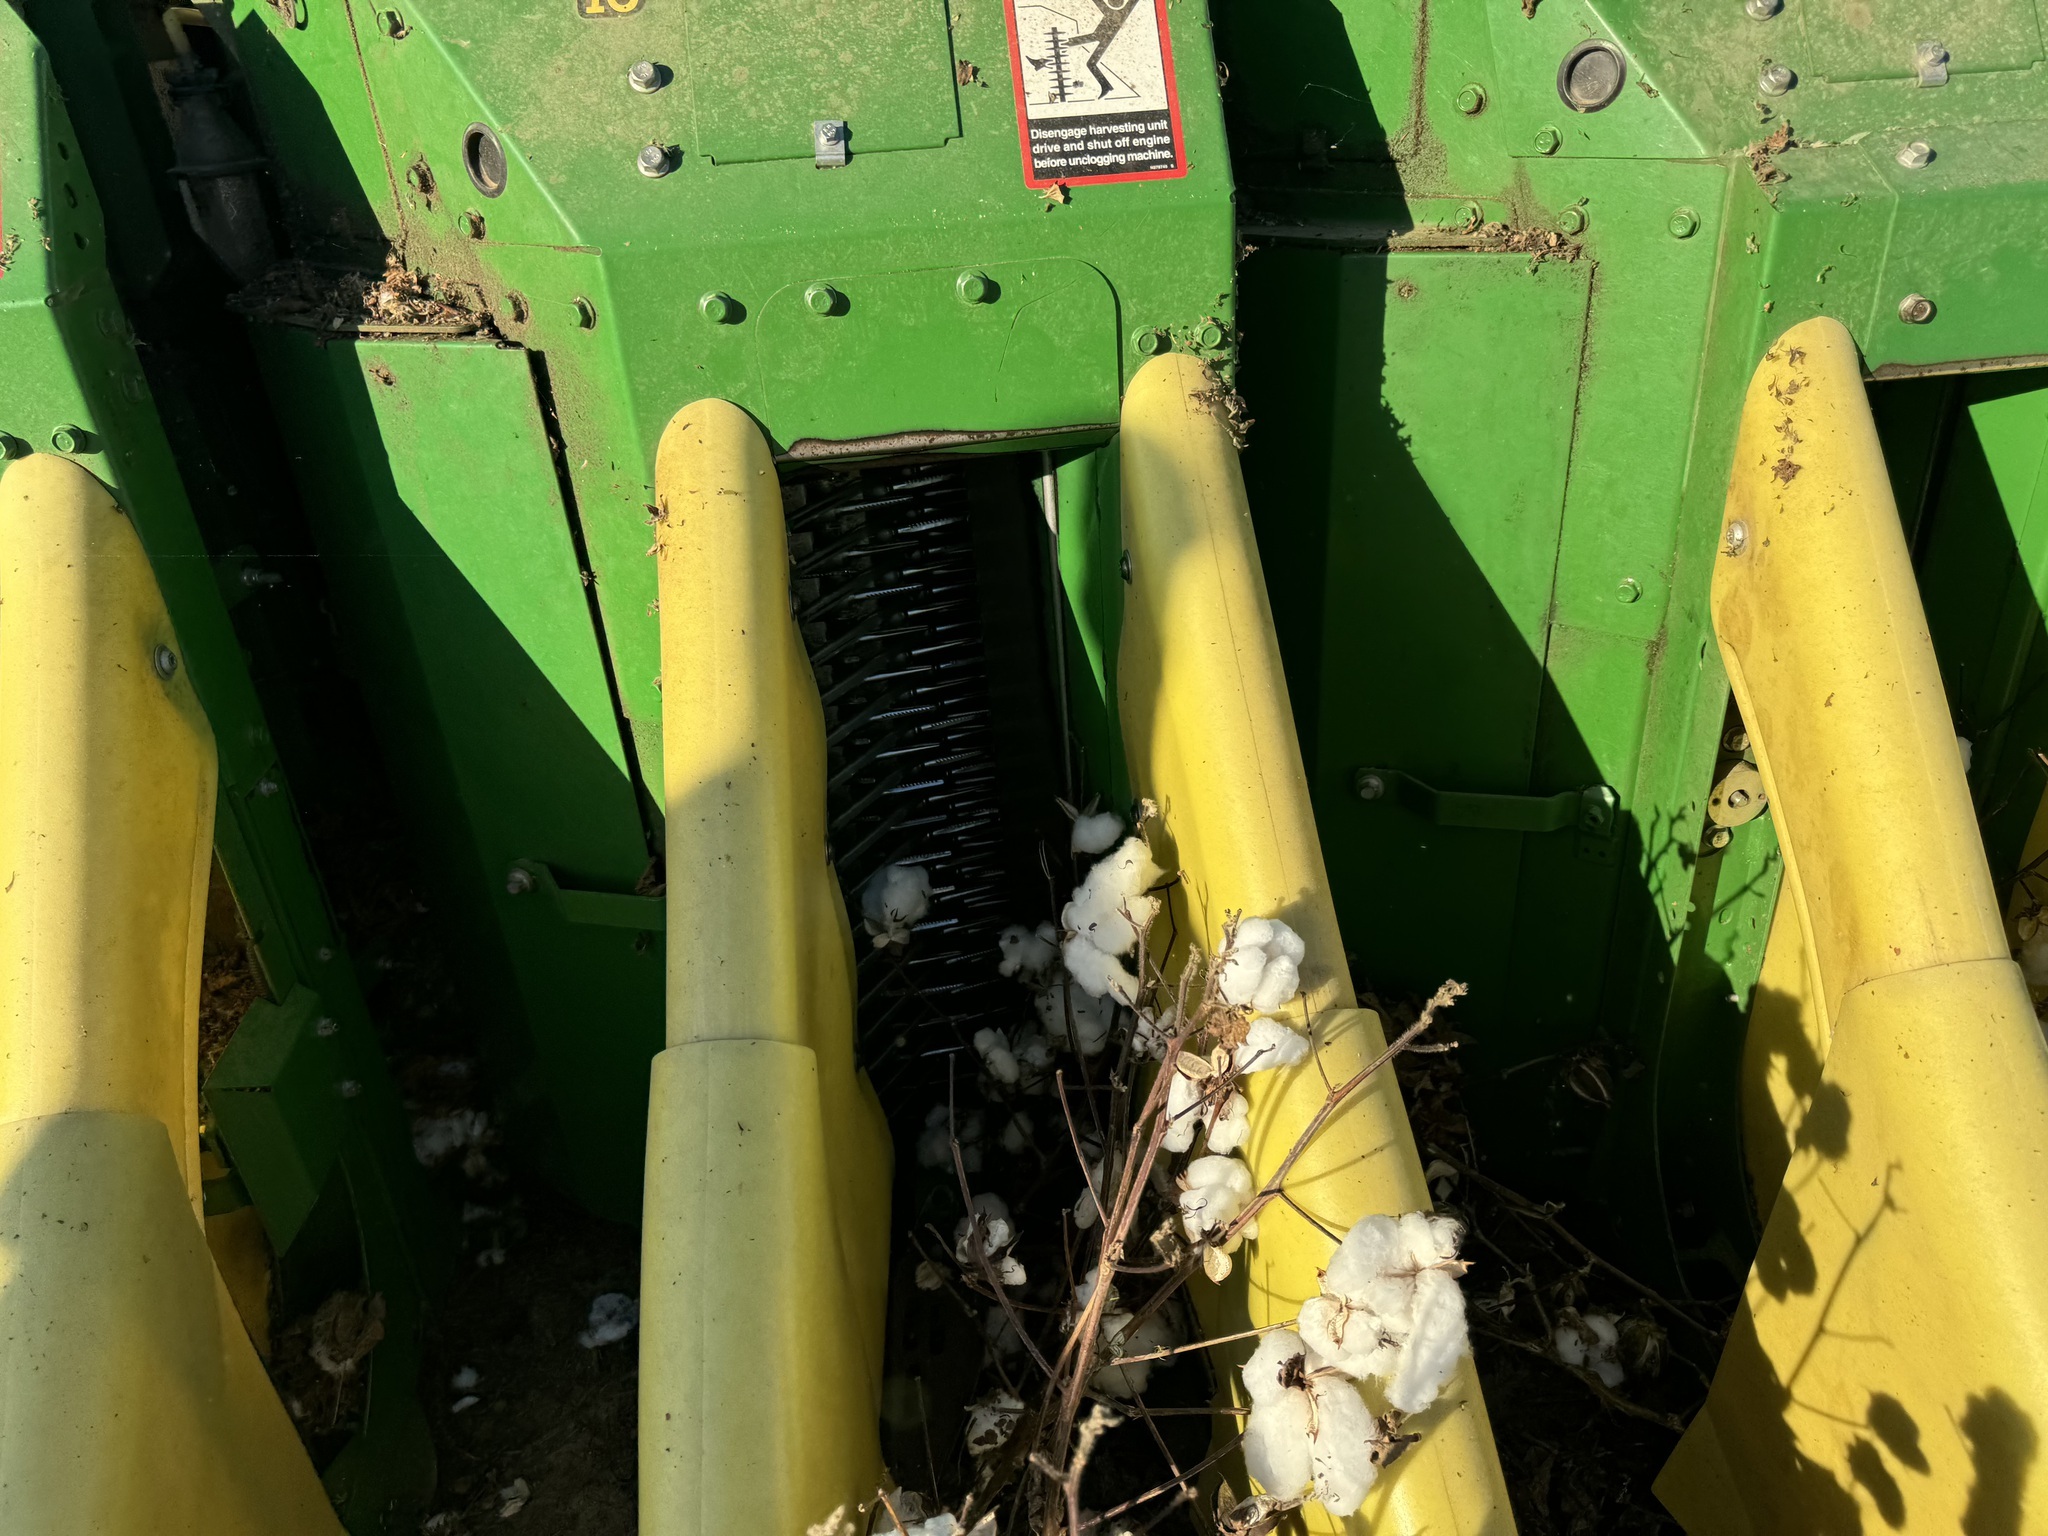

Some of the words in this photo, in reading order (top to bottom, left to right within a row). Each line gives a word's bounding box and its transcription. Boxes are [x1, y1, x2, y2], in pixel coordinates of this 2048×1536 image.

[1030, 127, 1087, 140] Disengage
[1089, 122, 1145, 135] harvesting
[1147, 119, 1168, 131] unit
[1032, 142, 1061, 154] drive
[1063, 140, 1085, 152] and
[1087, 138, 1113, 150] shut
[1114, 136, 1130, 148] off
[1132, 134, 1171, 148] engine
[1034, 156, 1067, 168] before
[1068, 152, 1126, 167] unclogging
[1127, 148, 1174, 162] machine.
